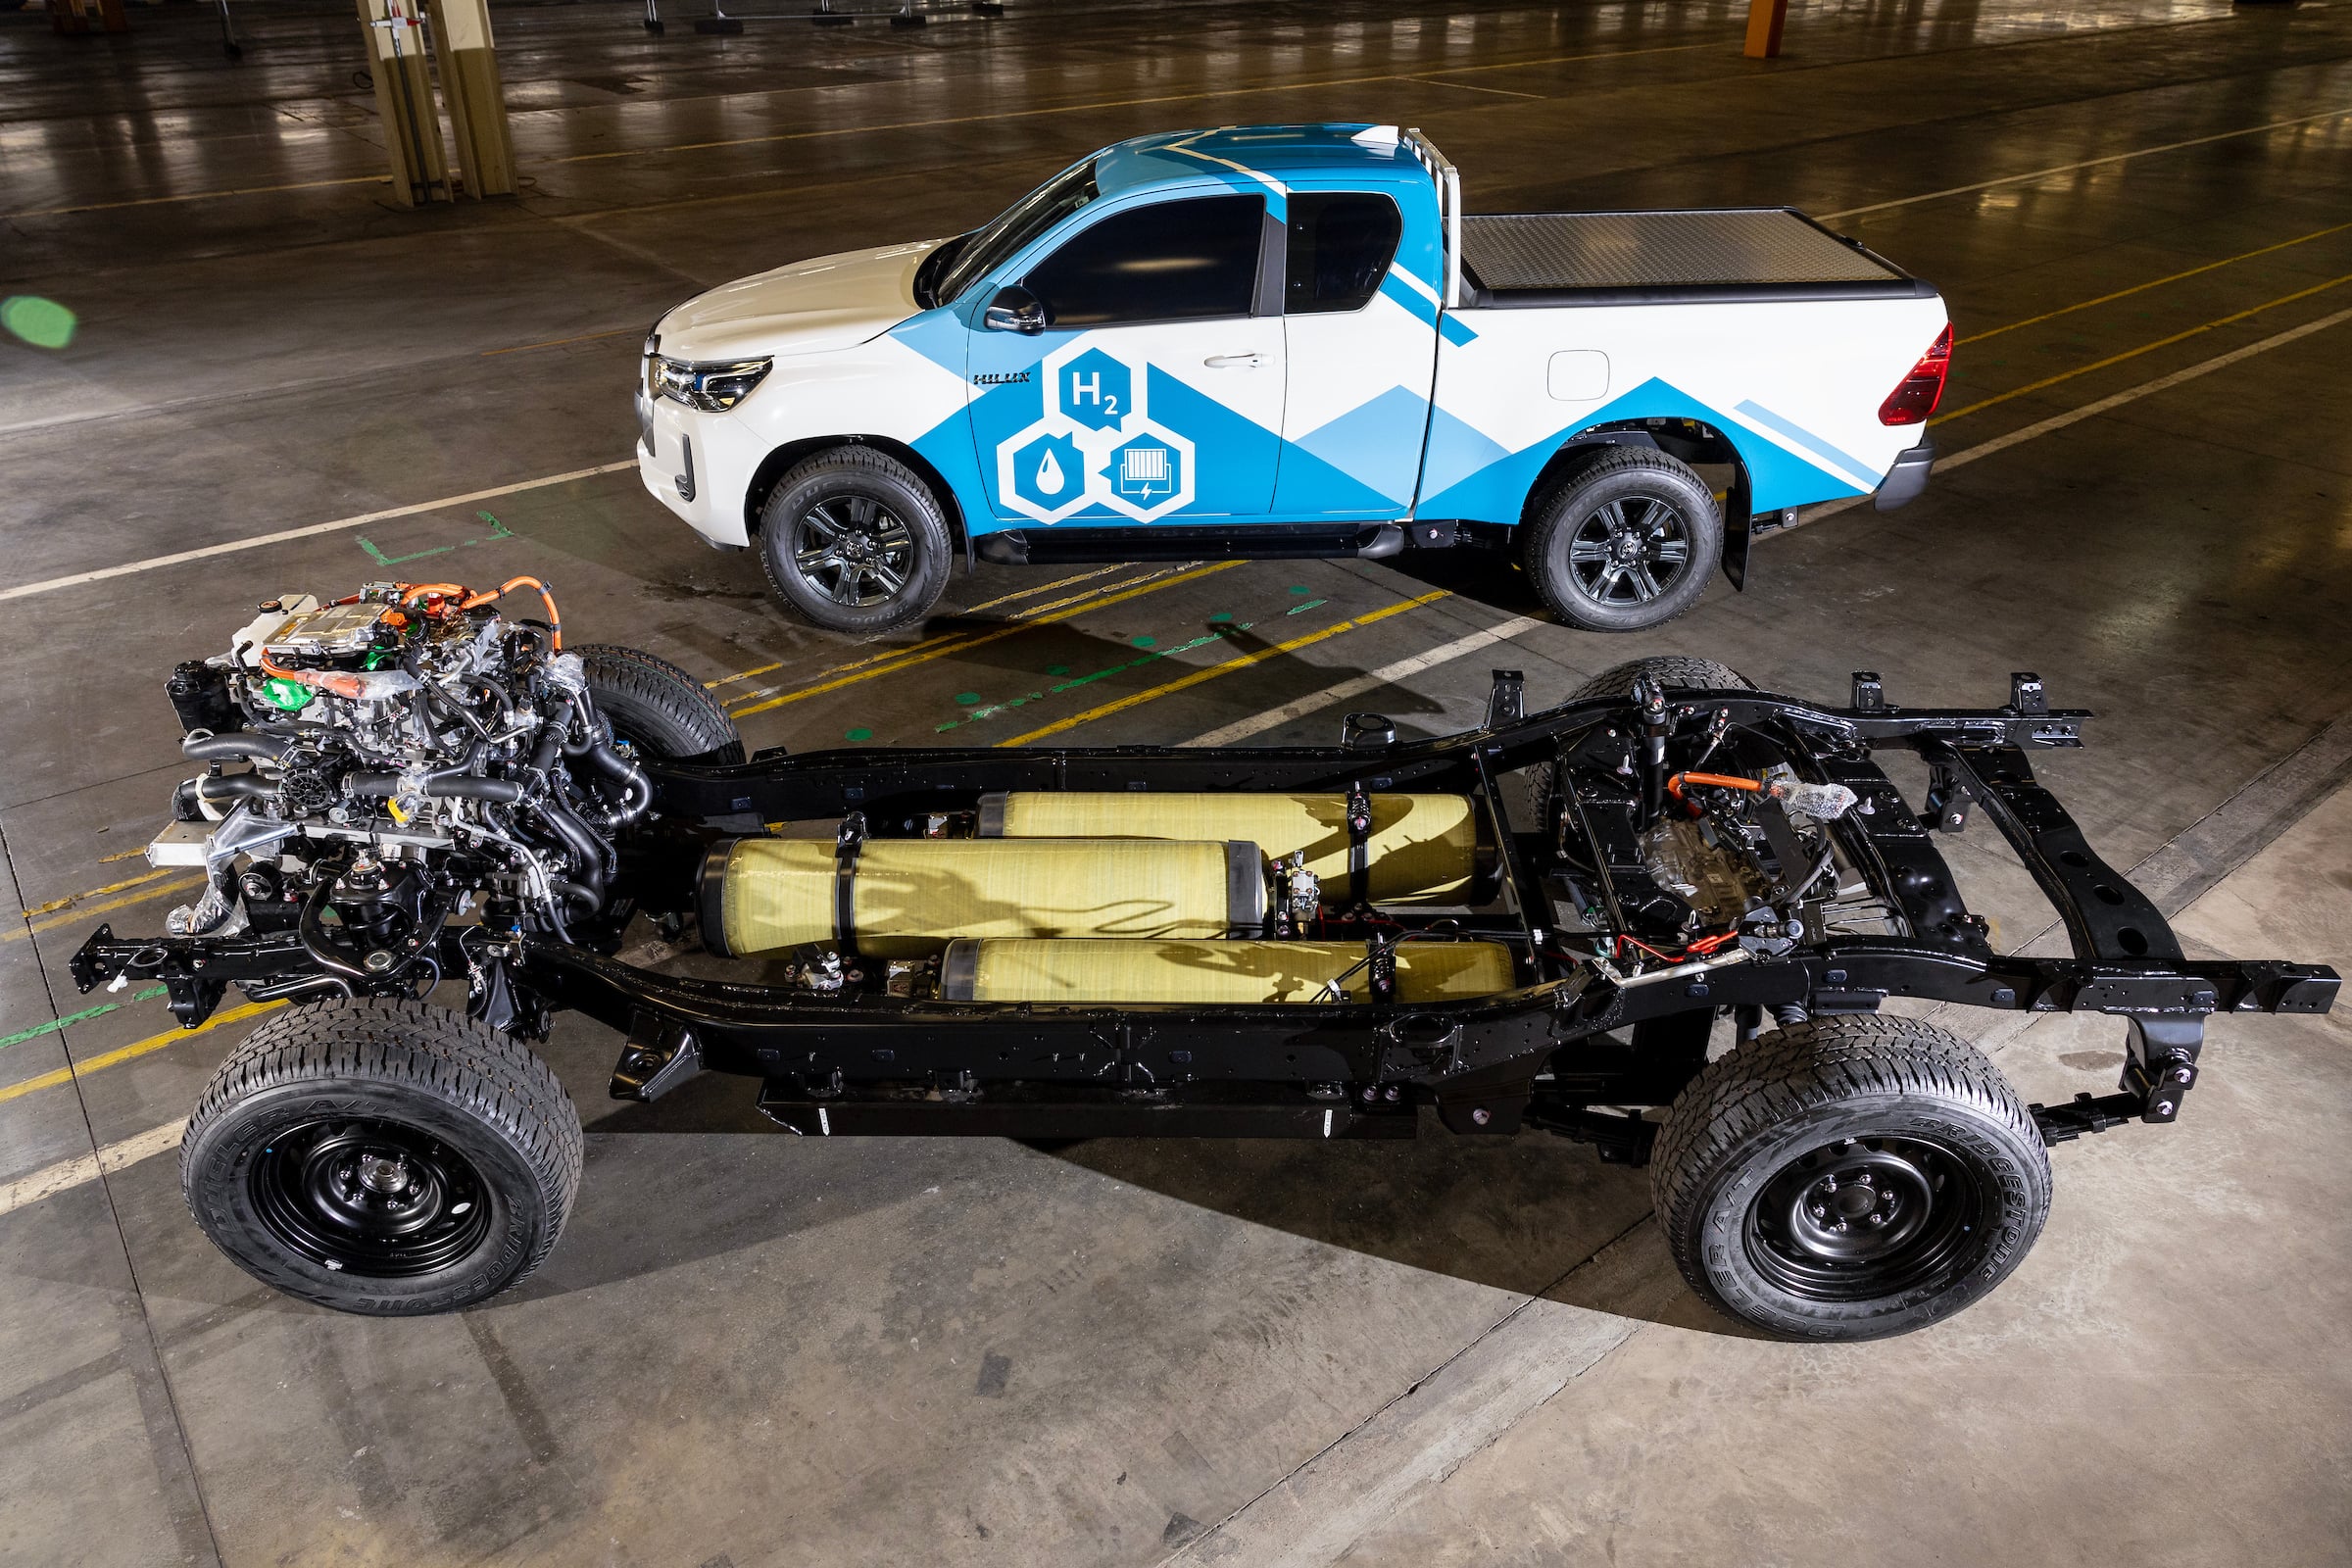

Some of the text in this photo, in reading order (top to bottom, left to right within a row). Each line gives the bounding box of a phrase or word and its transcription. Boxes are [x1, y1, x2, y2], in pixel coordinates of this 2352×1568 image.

[973, 371, 1031, 385] HILUX
[202, 1105, 291, 1233] DUELER
[1909, 1115, 2027, 1282] BRIDGESTONE
[352, 1193, 525, 1311] BRIDGESTONE
[1708, 1167, 1847, 1338] DUELER A/T
